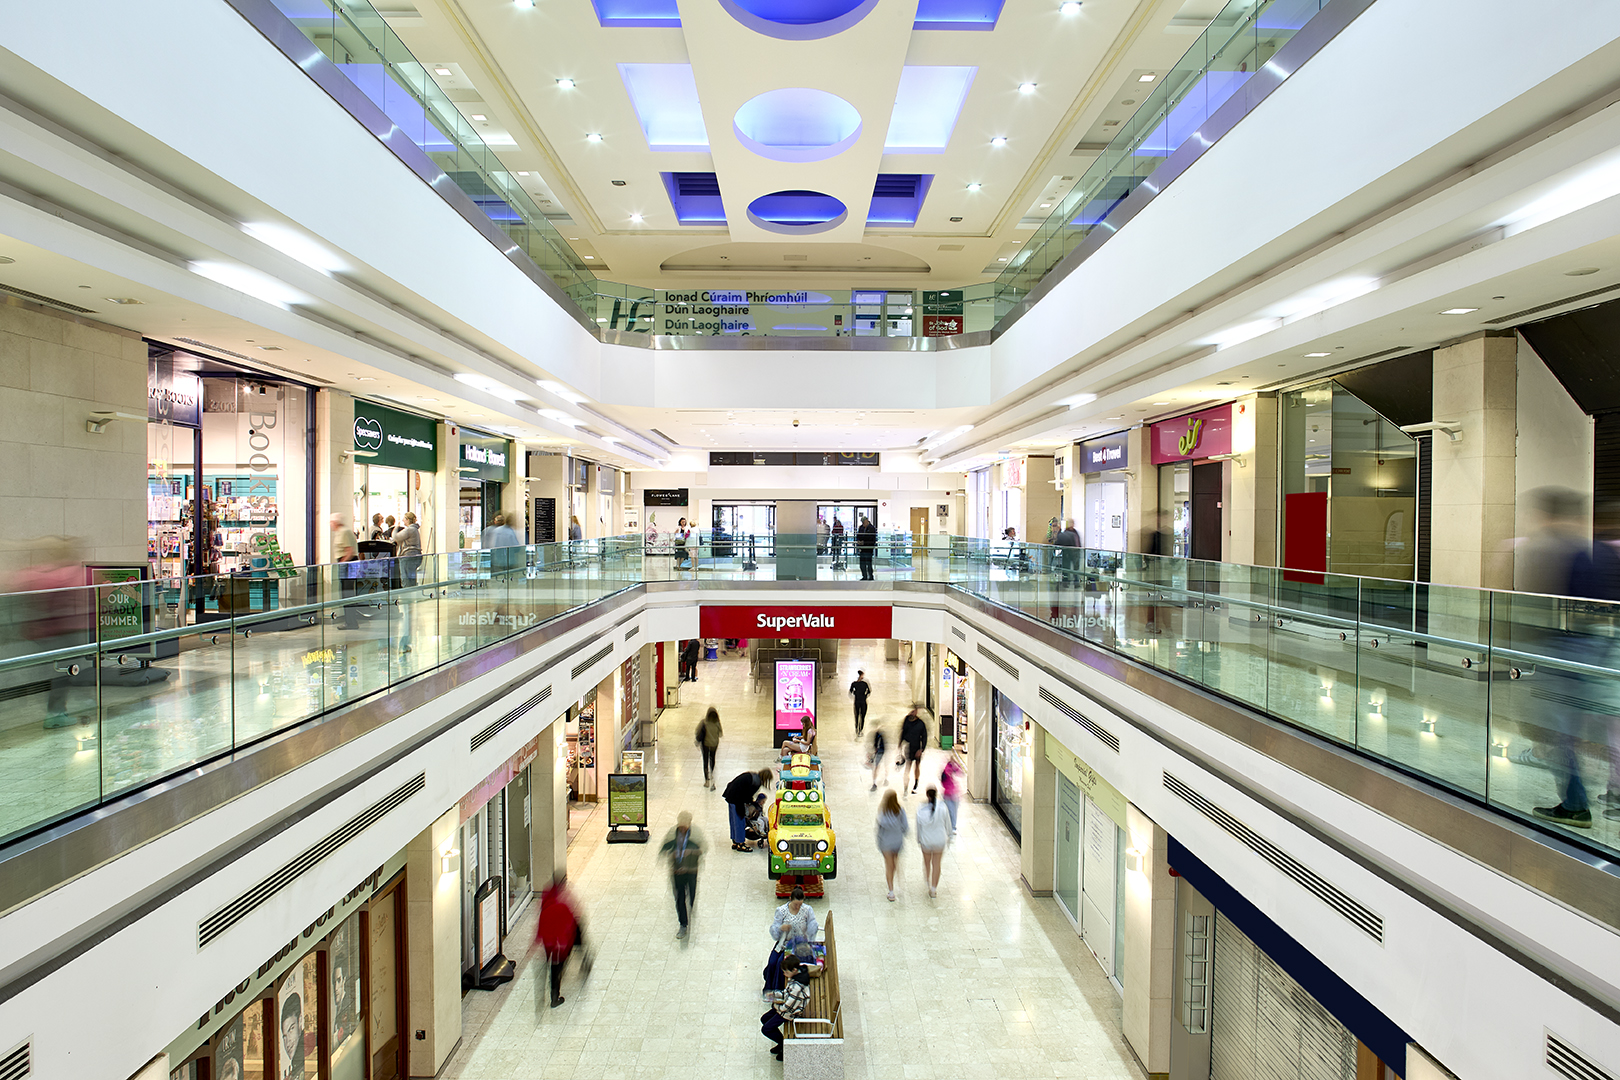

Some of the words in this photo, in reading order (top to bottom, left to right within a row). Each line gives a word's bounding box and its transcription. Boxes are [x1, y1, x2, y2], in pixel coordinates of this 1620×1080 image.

[665, 291, 698, 302] Ionad
[701, 291, 742, 302] Cúraim
[746, 292, 808, 303] Phríomhúil
[665, 304, 689, 315] Dún
[692, 304, 750, 317] Laoghaire
[665, 319, 689, 330] Dún
[692, 319, 750, 332] Laoghaire
[107, 593, 130, 604] OUR
[101, 604, 137, 615] DEADLY
[100, 615, 138, 626] SUMMER
[756, 613, 835, 631] SuperValu
